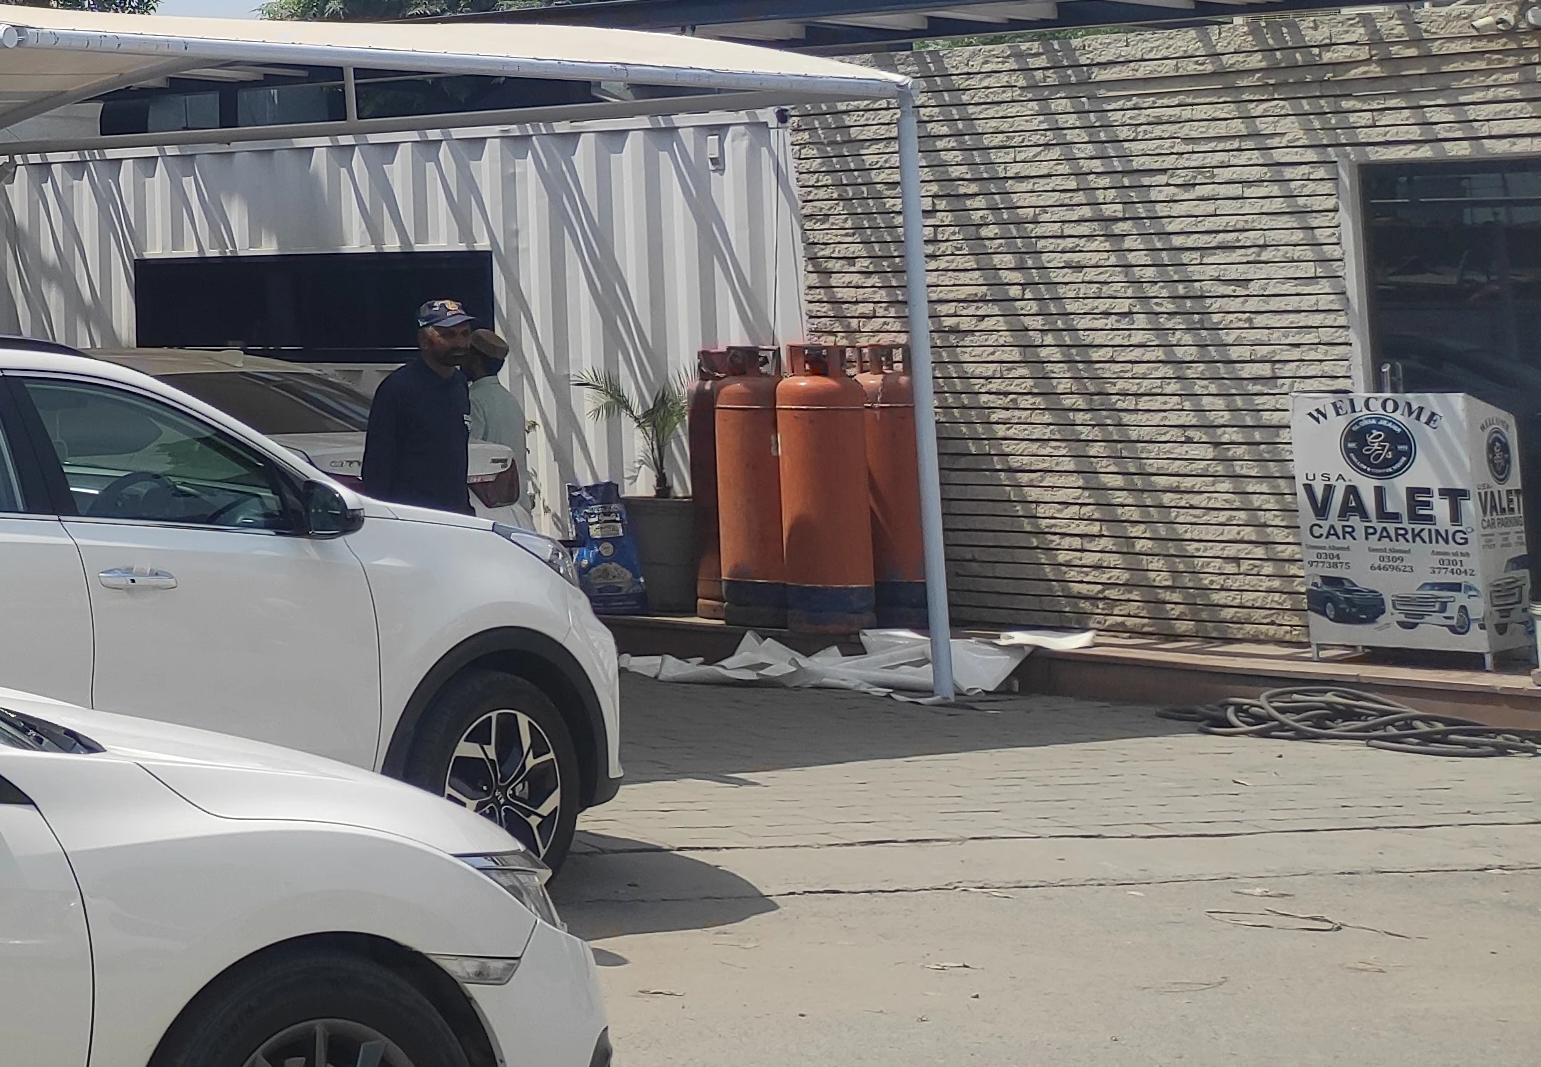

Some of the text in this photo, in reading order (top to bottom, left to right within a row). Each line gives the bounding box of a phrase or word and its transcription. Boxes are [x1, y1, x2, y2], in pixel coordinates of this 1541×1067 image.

[1306, 396, 1444, 430] WELCOME
[1302, 483, 1471, 526] VALET
[1477, 488, 1522, 516] VALET
[1481, 516, 1524, 530] CAR PARKING
[1309, 523, 1357, 541] CAR
[1364, 525, 1470, 546] PARKING
[1315, 551, 1341, 561] 0304
[1378, 555, 1405, 565] 0309
[1307, 560, 1351, 570] 9773875
[1369, 563, 1414, 573] 6469623
[1438, 558, 1464, 567] 0301
[1429, 566, 1476, 577] 3774042
